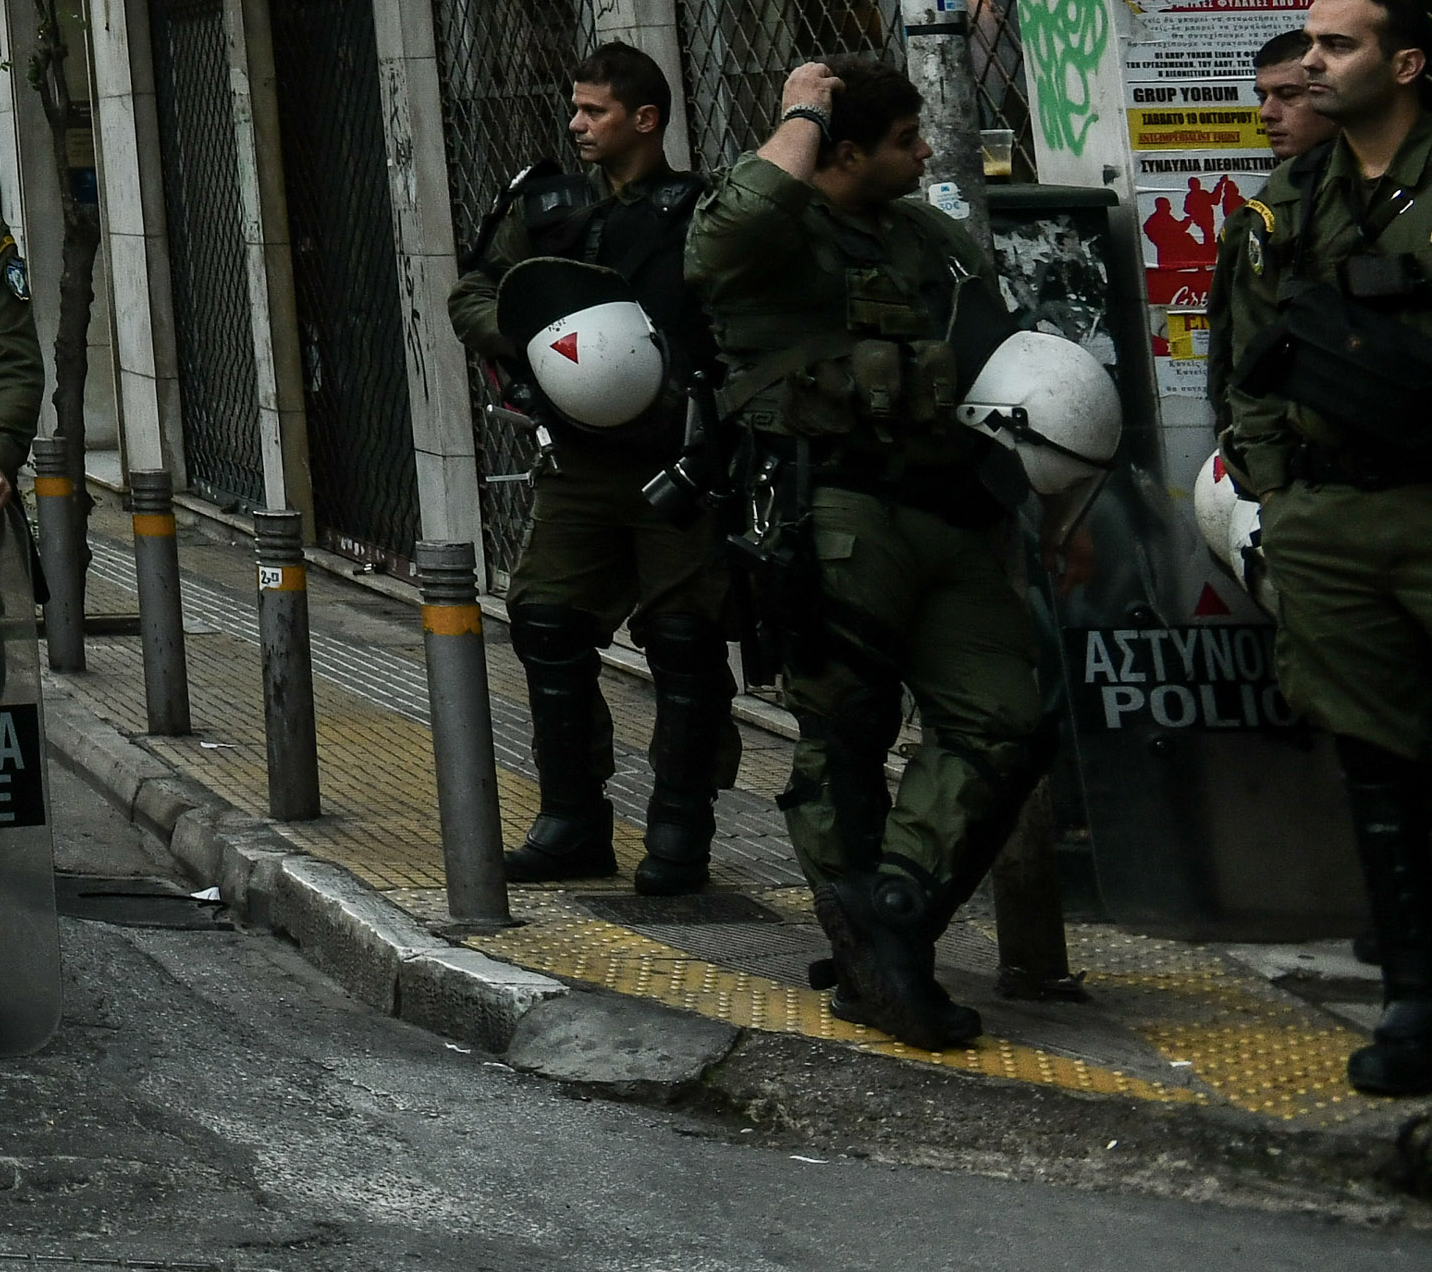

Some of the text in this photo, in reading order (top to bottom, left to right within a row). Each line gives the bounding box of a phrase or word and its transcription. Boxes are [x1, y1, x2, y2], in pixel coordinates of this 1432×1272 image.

[1133, 86, 1239, 102] GRUP YORUM
[1142, 112, 1252, 126] ΣΑΒΒΑΤΟ 19 ΟΚΤΩΒΡΙΟΥ
[1141, 157, 1280, 173] ΣΥΝΑΥΛΙΑ ΔΙΕΘΝΙΣΤΙΚΗ
[1101, 684, 1302, 729] POLIC
